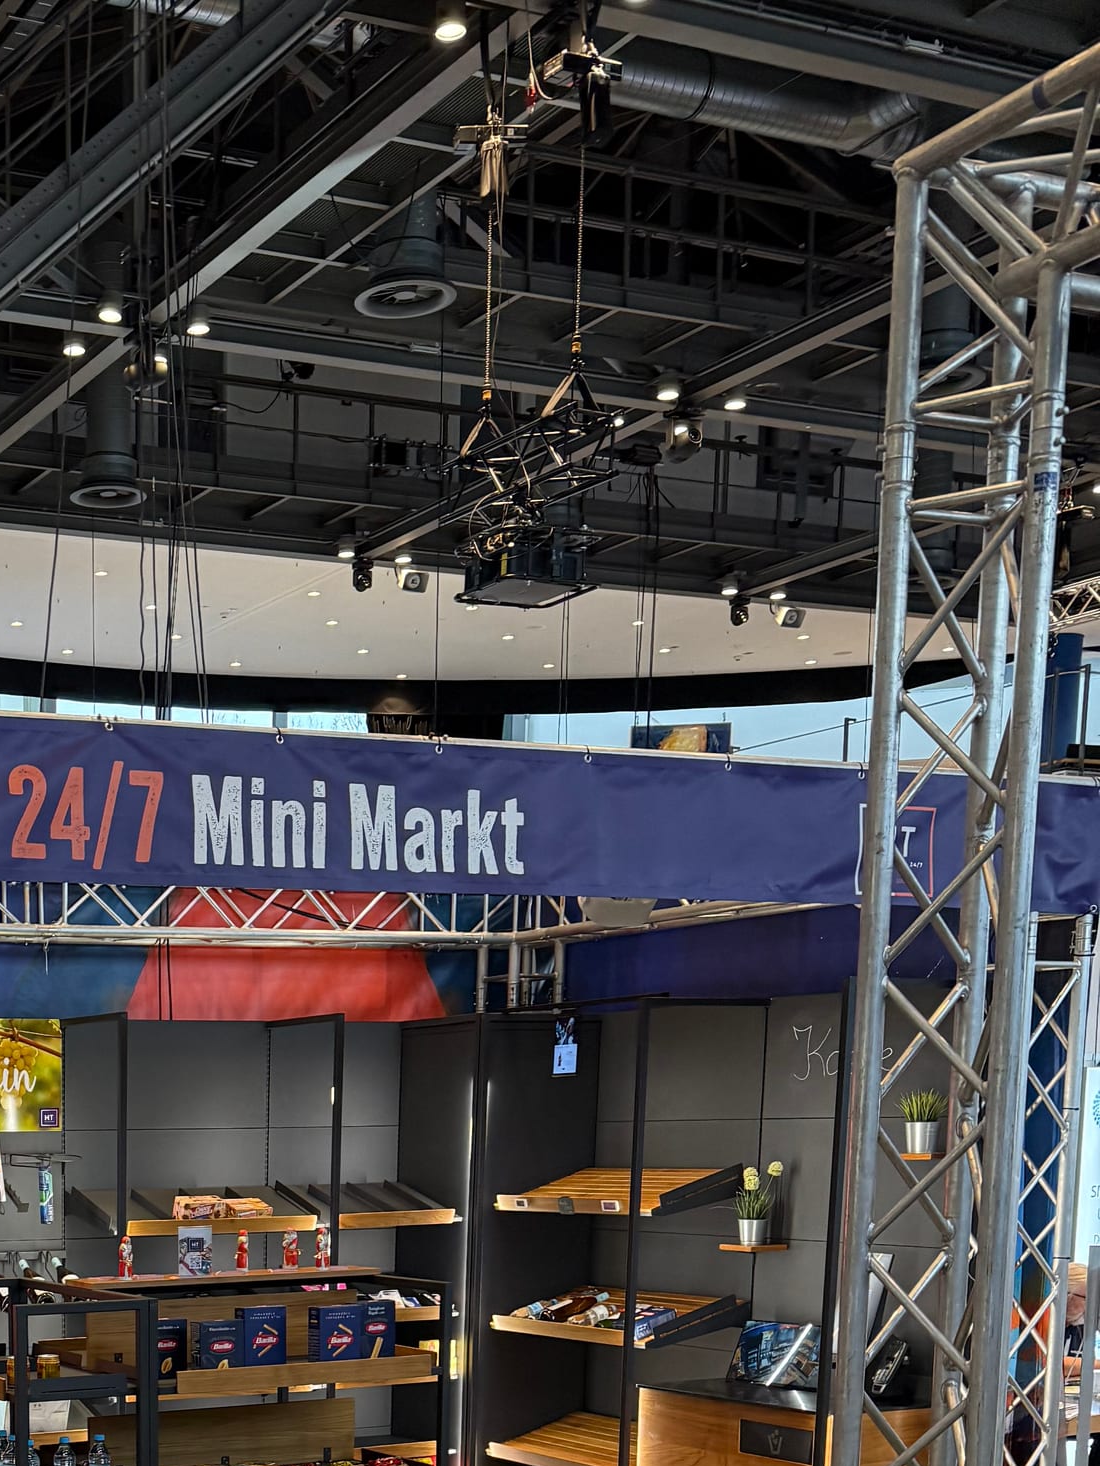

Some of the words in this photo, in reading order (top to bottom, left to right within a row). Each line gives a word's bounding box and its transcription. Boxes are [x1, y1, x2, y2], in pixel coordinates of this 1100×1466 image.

[8, 760, 164, 870] 24/7
[191, 773, 327, 869] Mini
[349, 782, 526, 876] Markt
